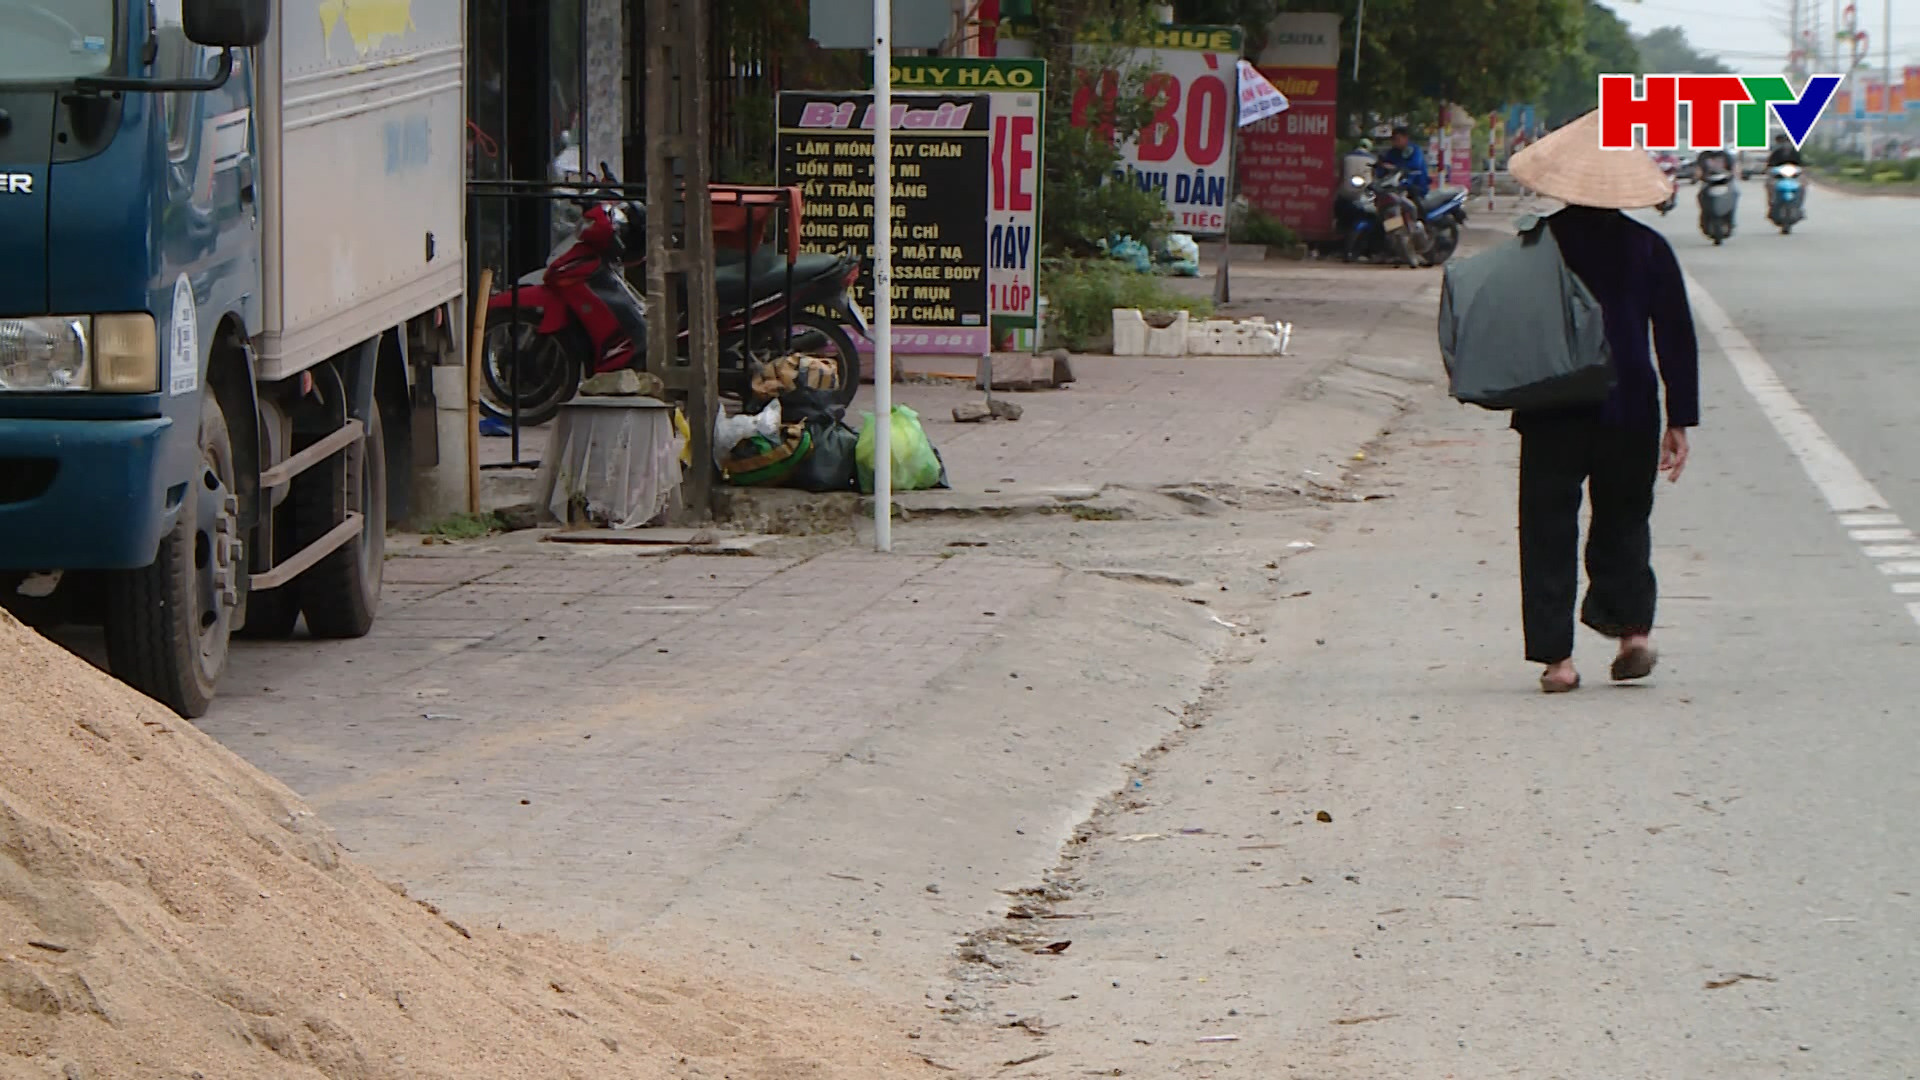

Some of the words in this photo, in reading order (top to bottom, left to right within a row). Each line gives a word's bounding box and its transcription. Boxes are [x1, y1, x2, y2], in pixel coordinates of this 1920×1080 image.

[957, 64, 1033, 87] HÀO
[798, 102, 856, 128] Bi
[860, 102, 973, 129] Nail
[918, 141, 962, 157] CHÂN
[833, 163, 853, 176] MI
[868, 165, 896, 177] NI
[900, 164, 920, 177] MI
[1175, 168, 1225, 207] DÂN
[874, 266, 941, 279] ASSAGE
[912, 304, 955, 321] CHÂN
